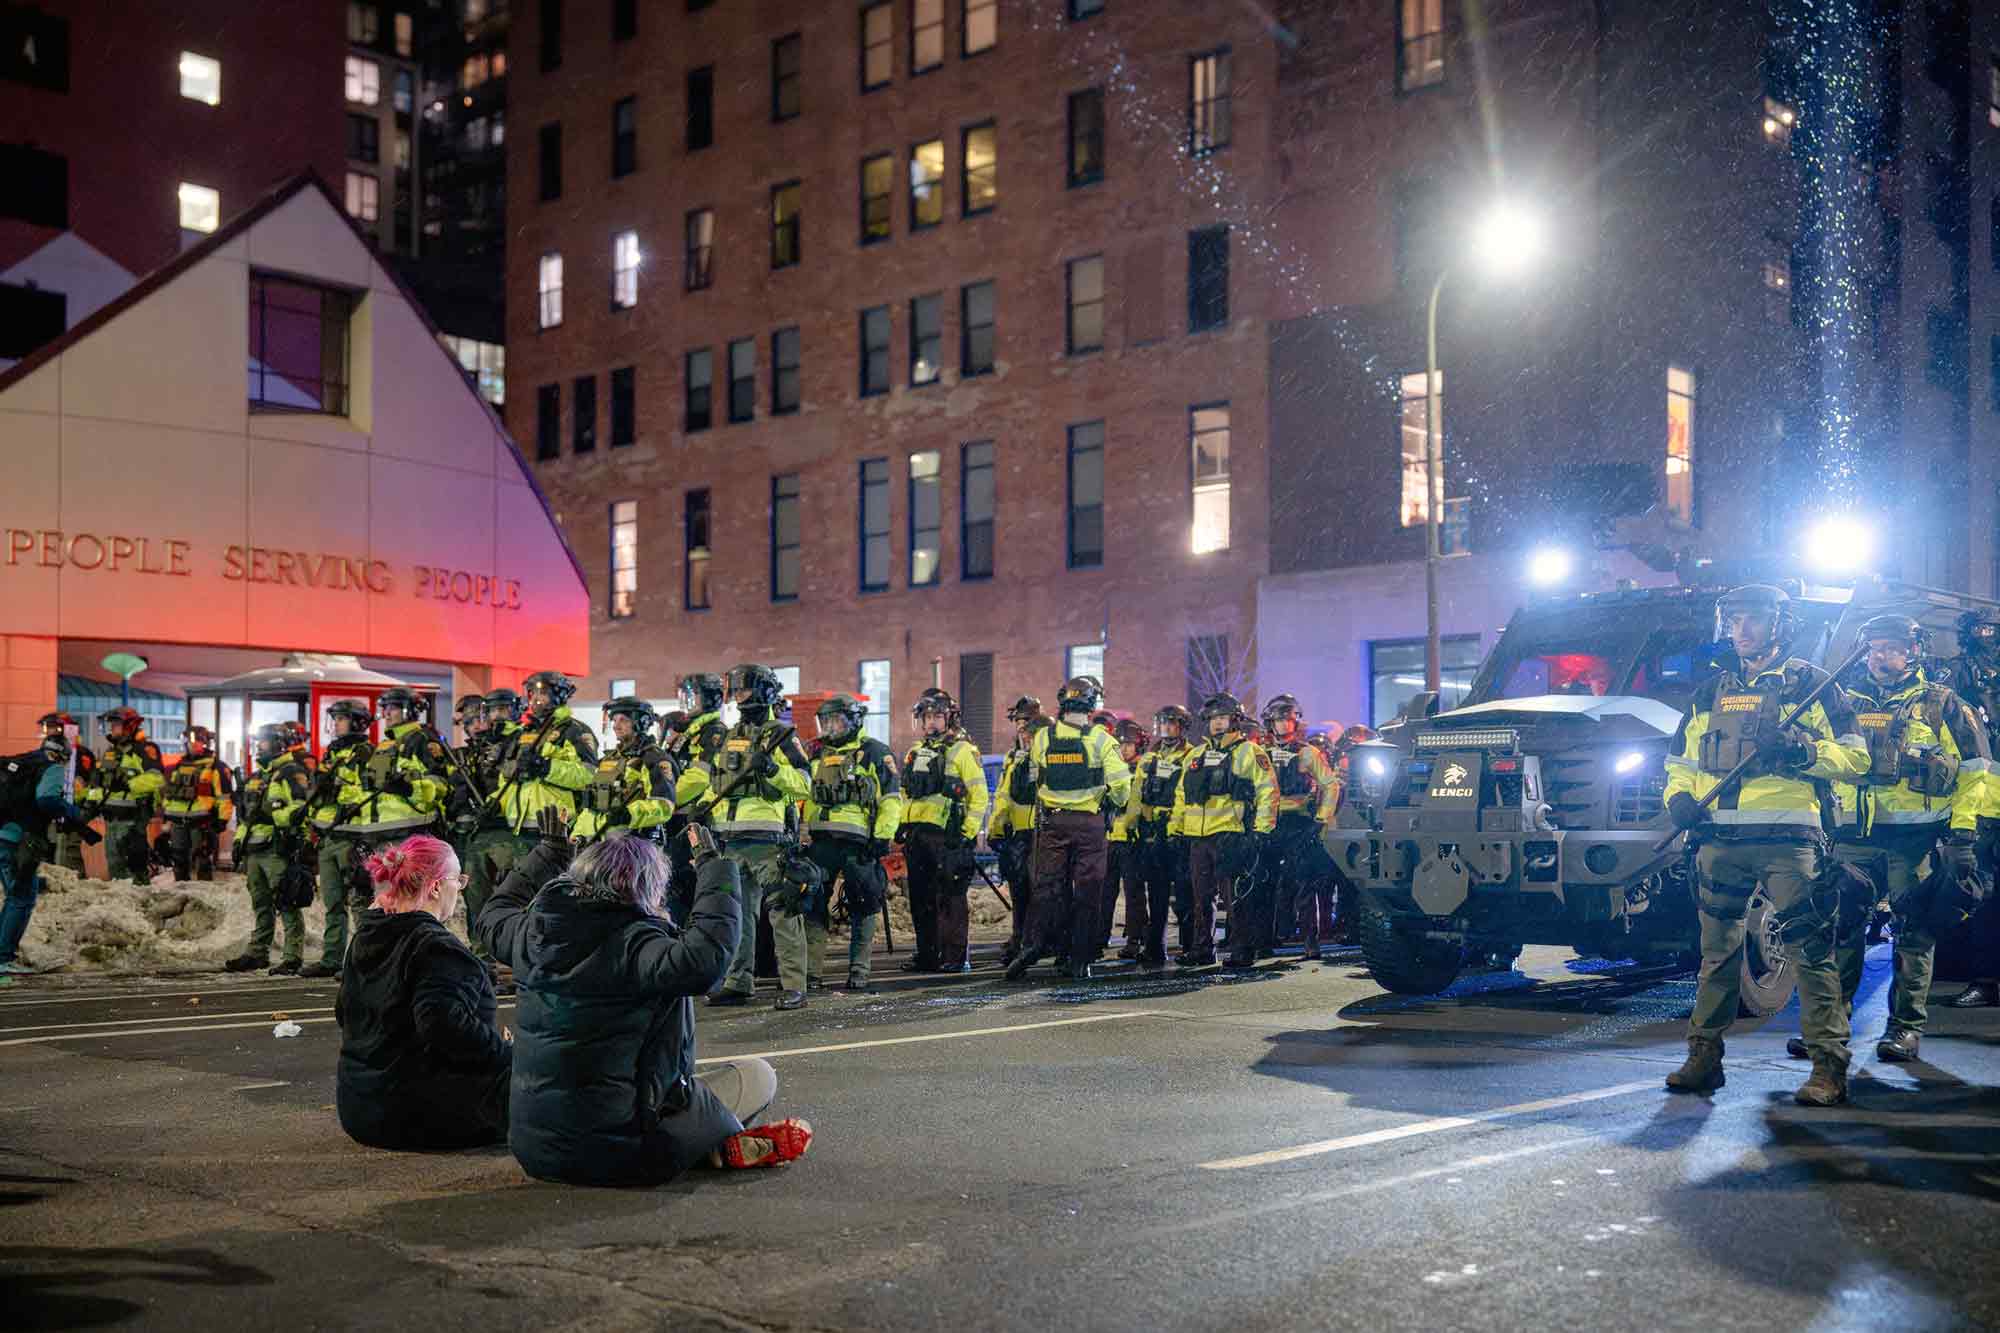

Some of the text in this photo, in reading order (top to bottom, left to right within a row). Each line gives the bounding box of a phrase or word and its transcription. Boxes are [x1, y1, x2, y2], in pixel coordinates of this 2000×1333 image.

[4, 529, 521, 610] PEOPLE SERVING PEOPLE
[1431, 788, 1473, 797] LENCO
